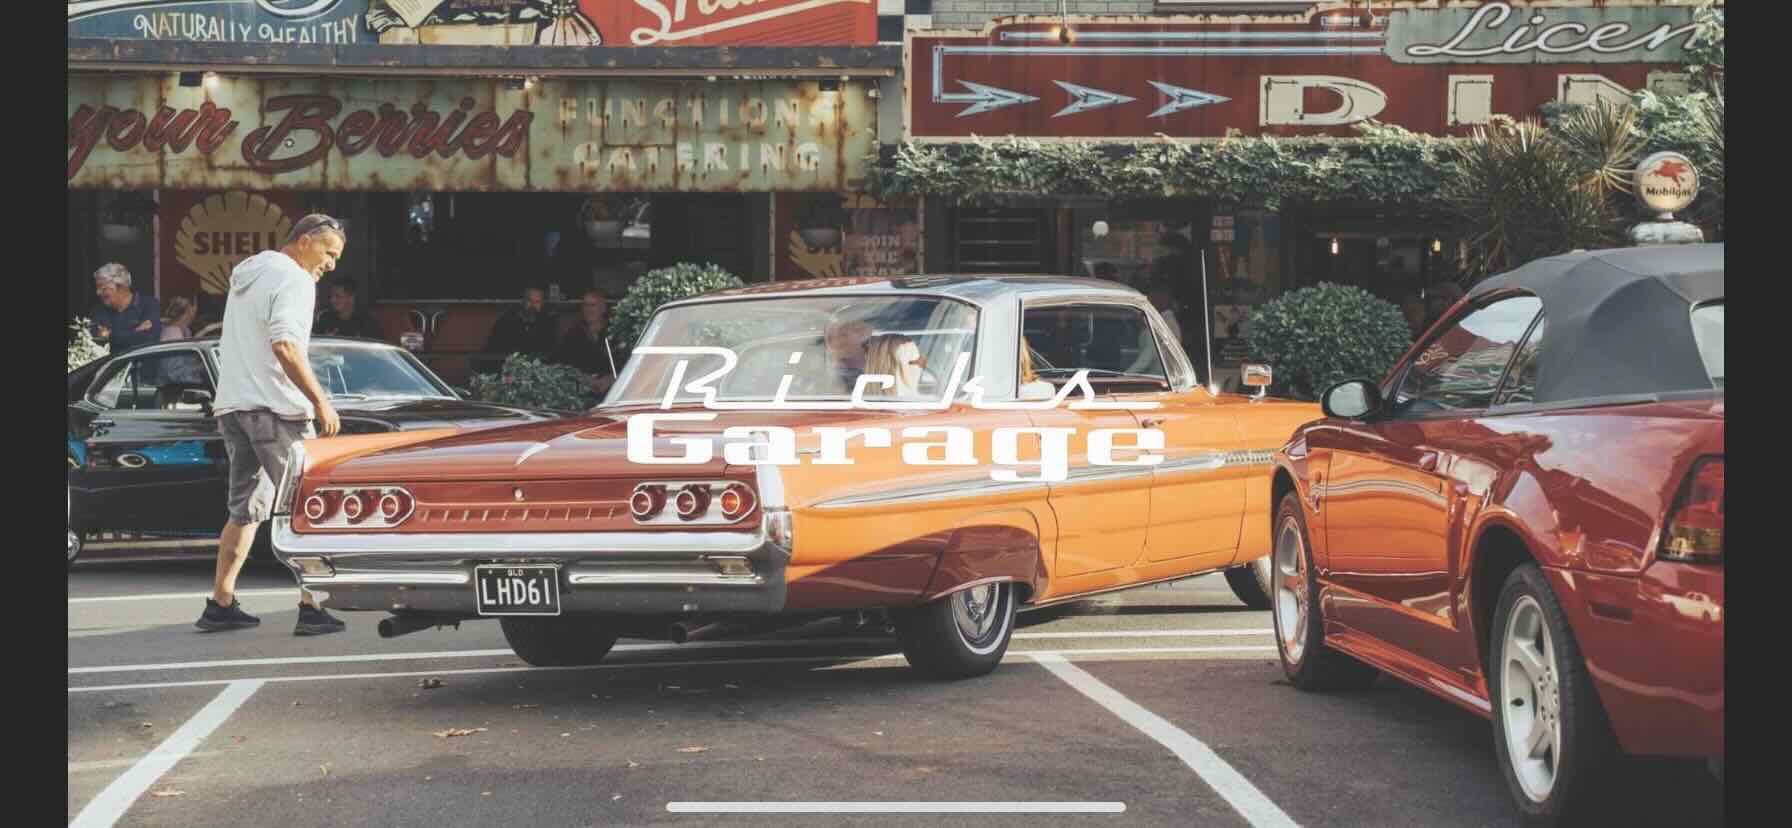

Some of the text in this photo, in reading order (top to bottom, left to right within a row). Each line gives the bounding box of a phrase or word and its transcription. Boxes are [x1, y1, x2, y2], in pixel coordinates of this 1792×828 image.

[133, 12, 359, 45] NATURALLY HEALTHY
[559, 98, 837, 130] FUNCTIONS
[68, 94, 534, 181] your Berries
[573, 143, 820, 172] CATERING
[1646, 186, 1692, 199] Mobilgas
[482, 577, 550, 605] LHD61
